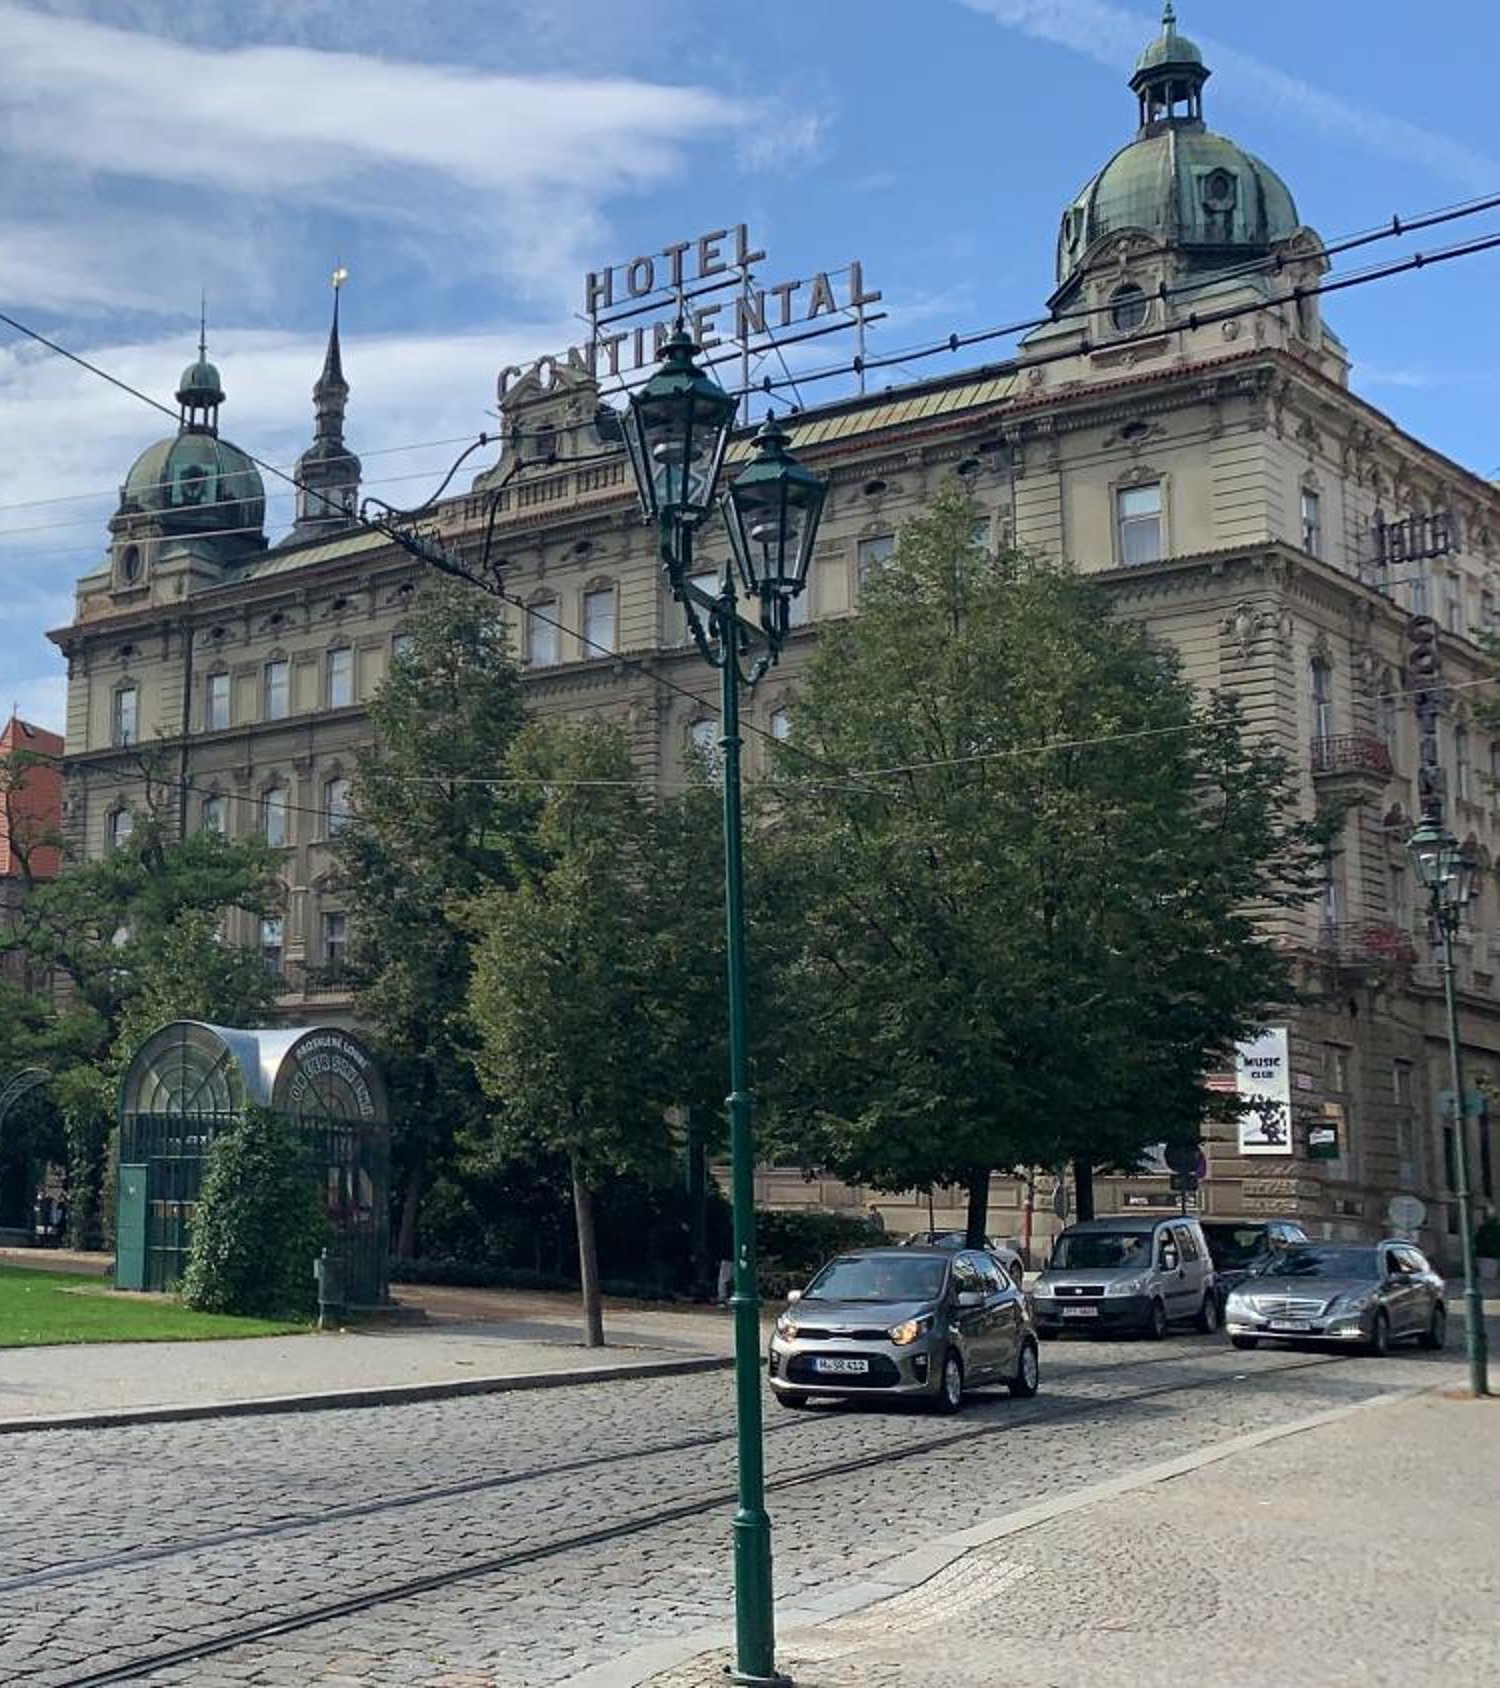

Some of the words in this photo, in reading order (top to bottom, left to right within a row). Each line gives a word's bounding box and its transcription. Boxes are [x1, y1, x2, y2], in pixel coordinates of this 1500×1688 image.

[585, 223, 766, 314] HOTEL
[498, 260, 882, 401] CONTINENTAL
[1243, 1057, 1282, 1068] MUSIC
[1251, 1070, 1275, 1079] CLUB
